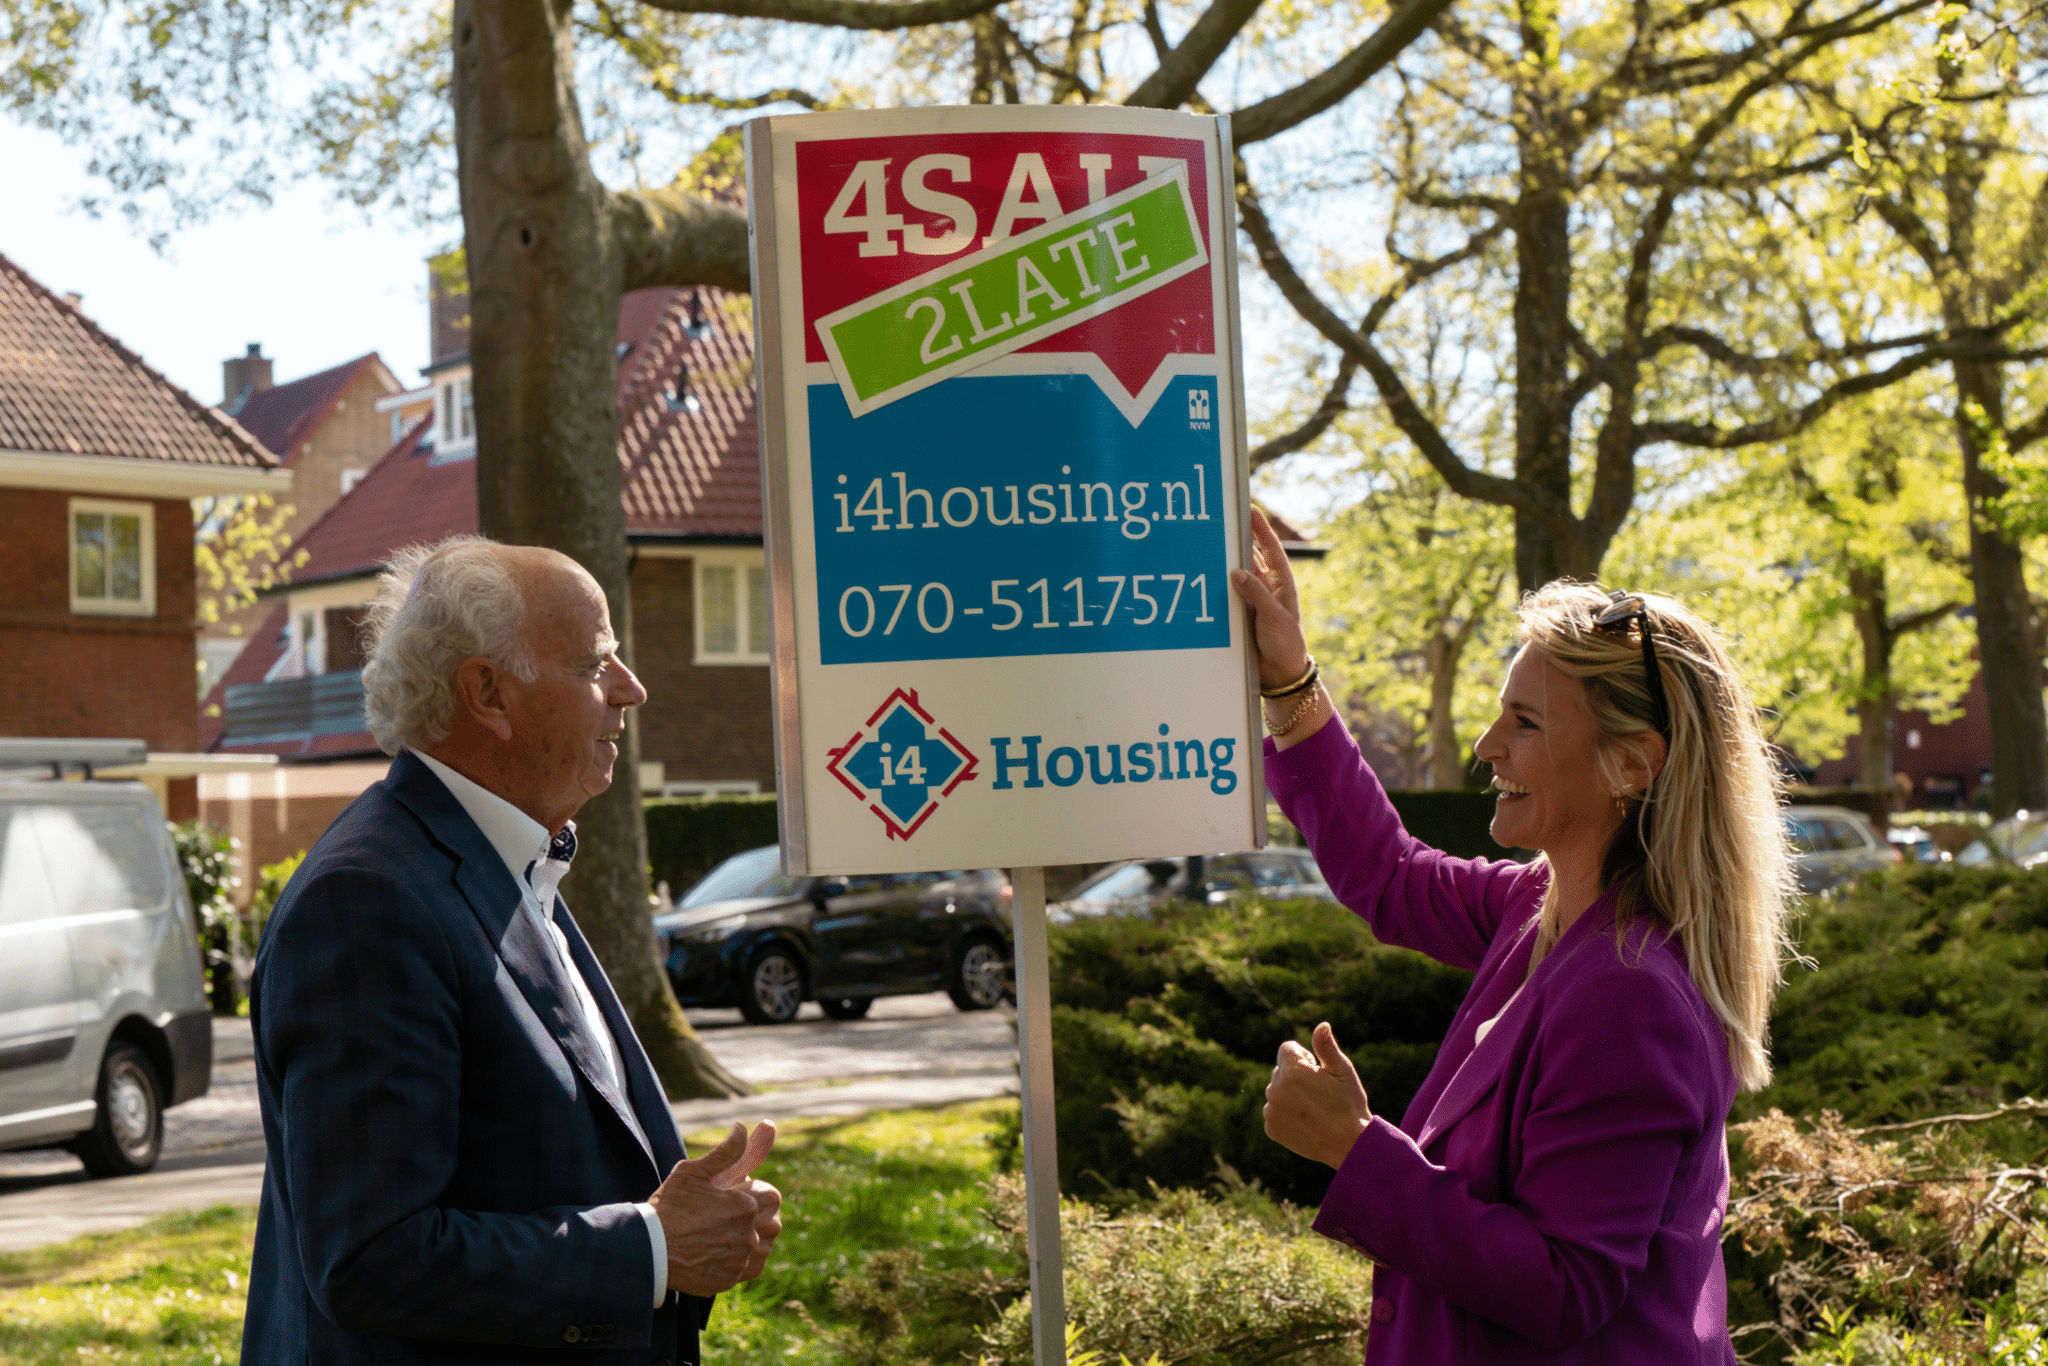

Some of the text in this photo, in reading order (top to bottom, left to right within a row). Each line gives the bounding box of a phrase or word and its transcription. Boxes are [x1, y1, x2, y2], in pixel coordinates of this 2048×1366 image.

[824, 152, 1188, 257] 4SA
[905, 212, 1150, 365] 2LATE
[1189, 422, 1210, 430] NVM
[834, 465, 1210, 540] i4housing.nl
[839, 574, 1215, 638] 070-5117571
[879, 723, 1237, 796] i4 Housing
